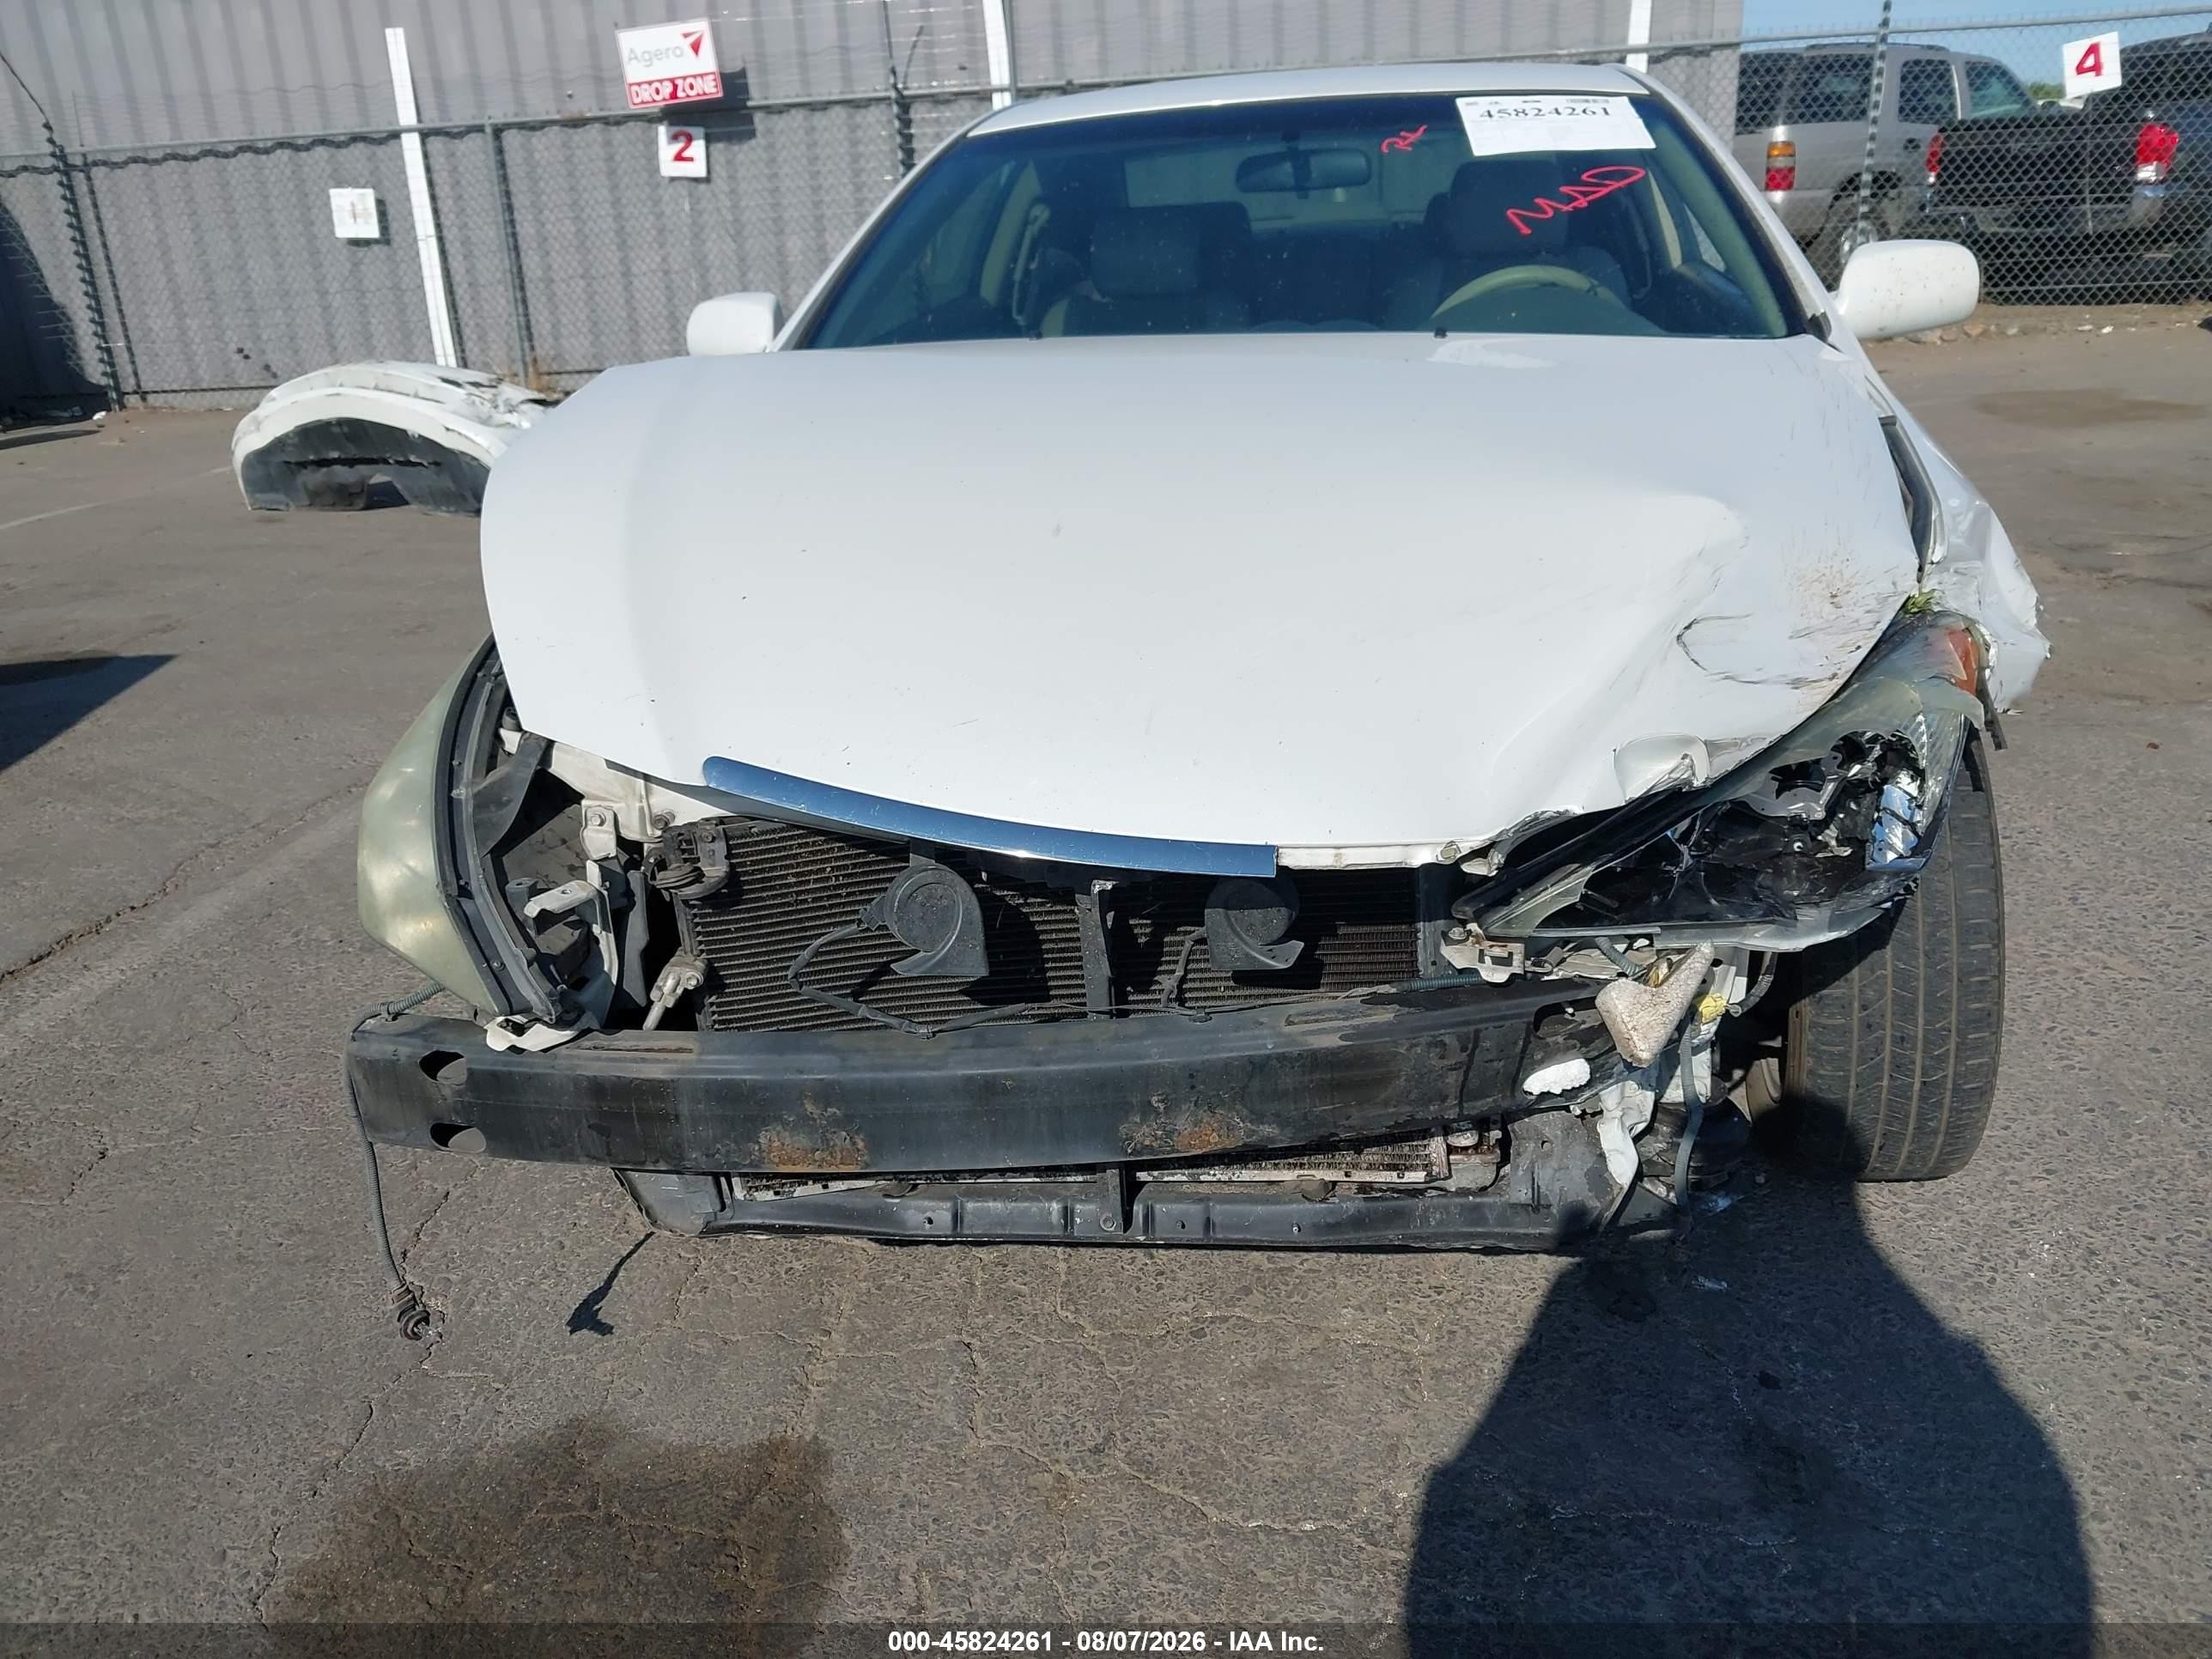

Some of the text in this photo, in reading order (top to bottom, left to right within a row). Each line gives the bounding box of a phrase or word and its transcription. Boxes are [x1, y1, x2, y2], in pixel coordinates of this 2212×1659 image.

[628, 45, 684, 68] Agero
[2075, 41, 2102, 77] 4
[631, 75, 717, 105] DROP ZONE
[1480, 106, 1611, 119] 45824261
[672, 130, 695, 161] 2
